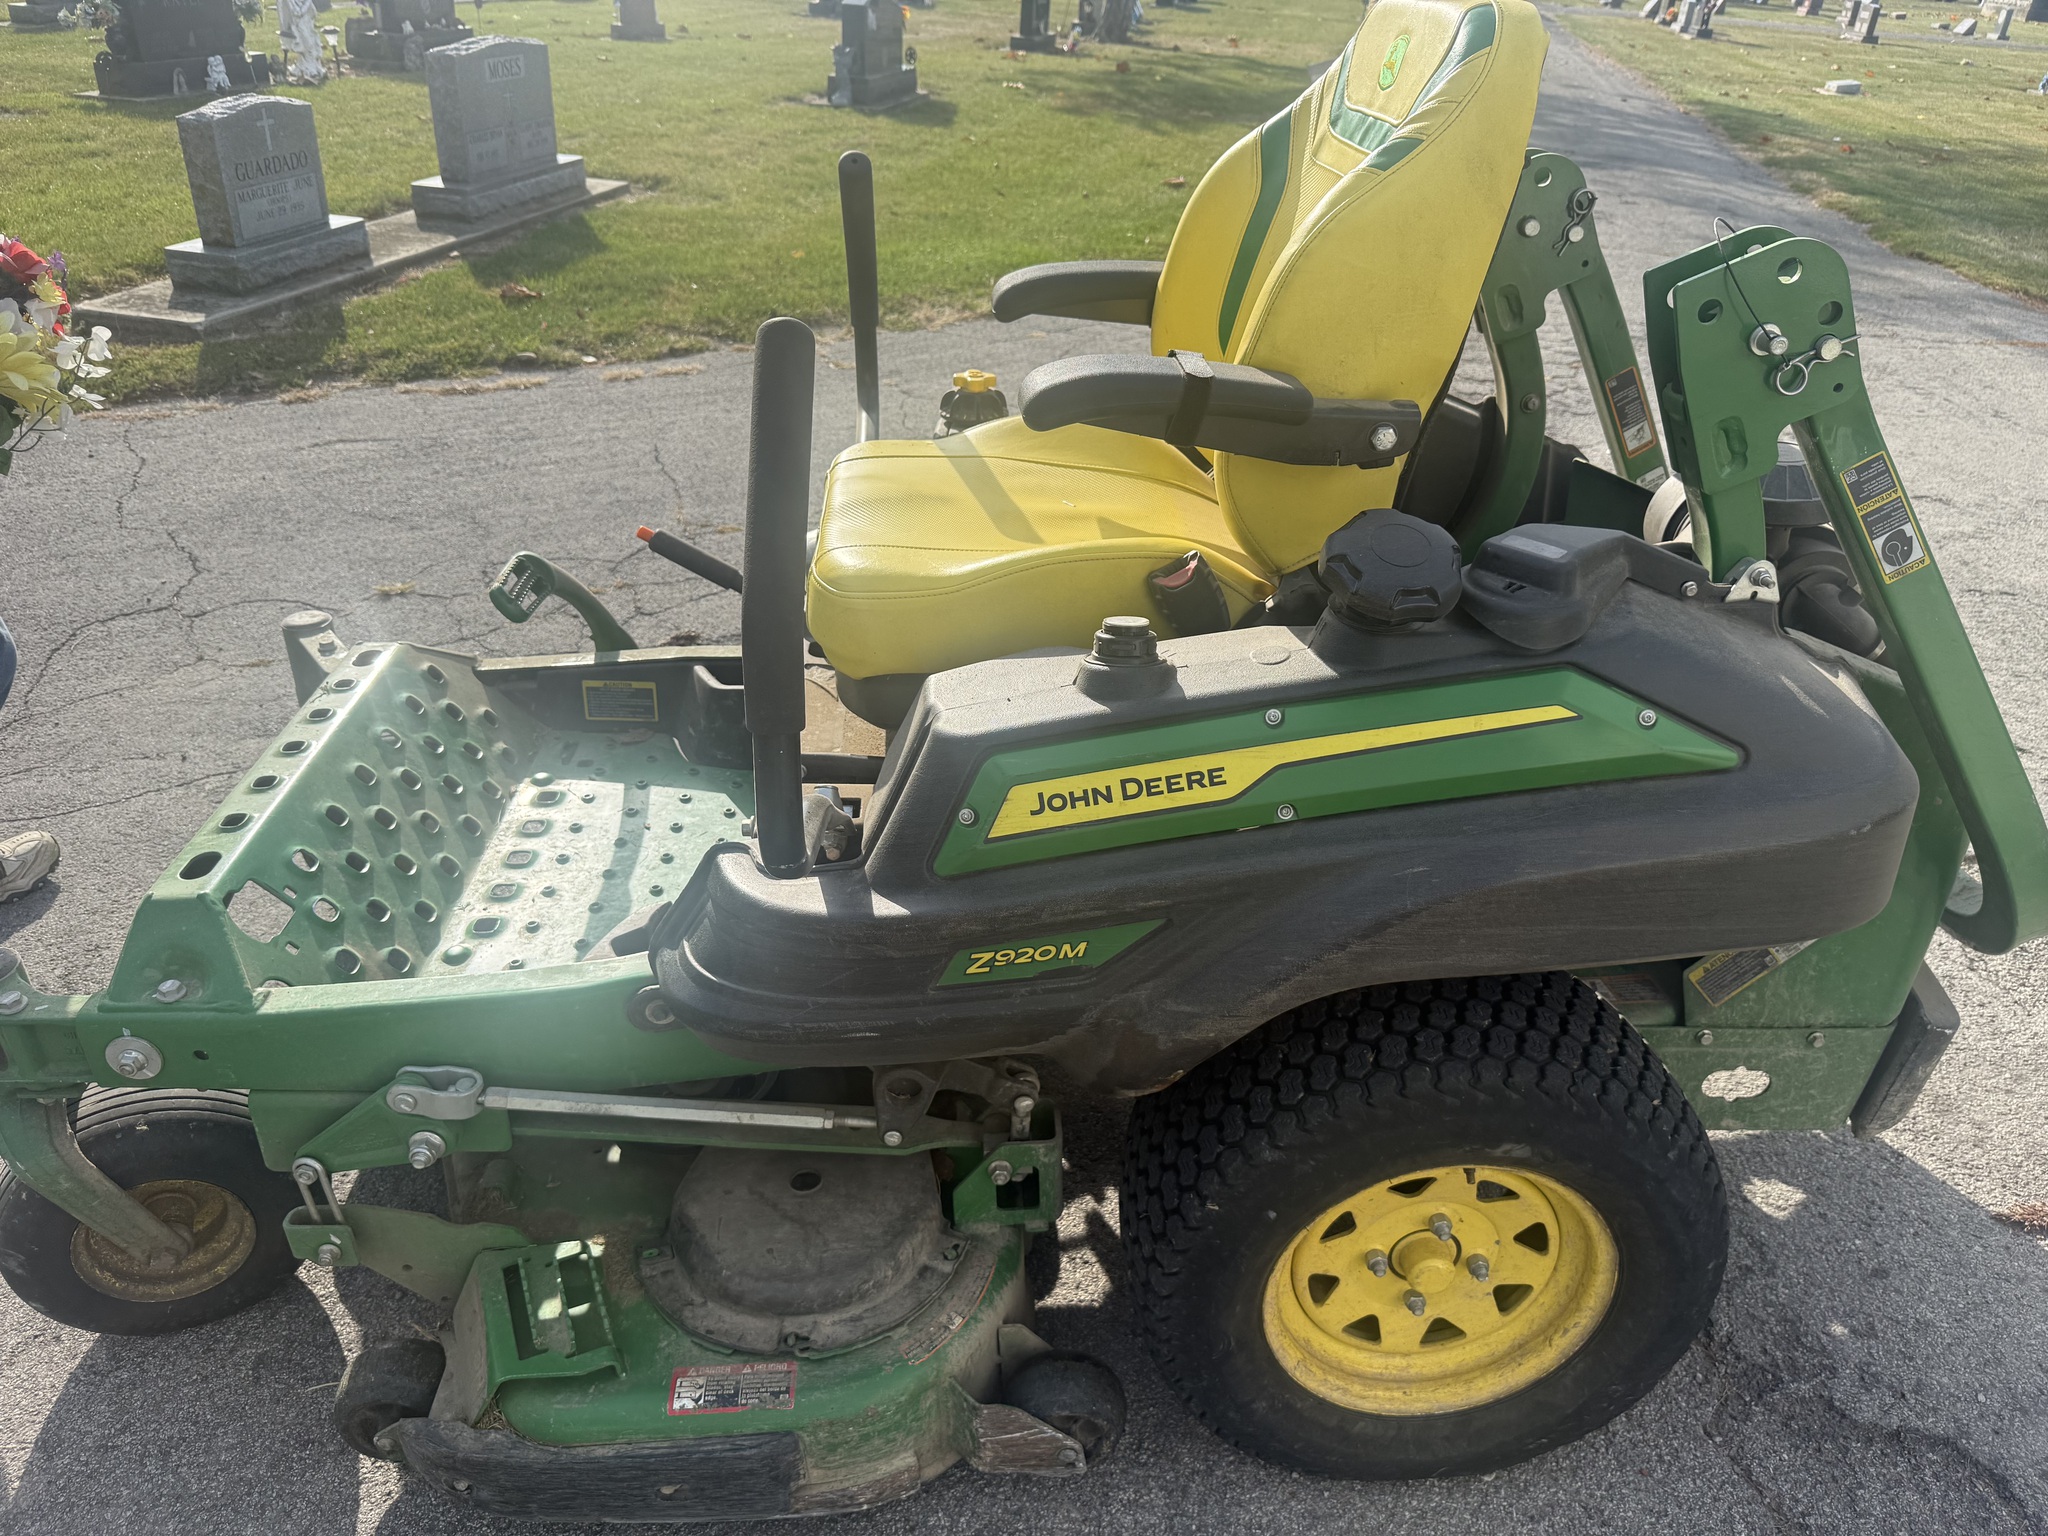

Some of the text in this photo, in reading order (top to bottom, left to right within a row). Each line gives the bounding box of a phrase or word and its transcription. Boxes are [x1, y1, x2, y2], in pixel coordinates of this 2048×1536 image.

[488, 58, 522, 80] MOSES
[235, 150, 308, 181] GUARDADO
[237, 182, 290, 202] MARGUERITE
[294, 176, 314, 191] JUNE
[1888, 562, 1921, 582] CAUTION
[1030, 767, 1227, 816] JOHN DEERE
[964, 941, 1089, 975] Z920M
